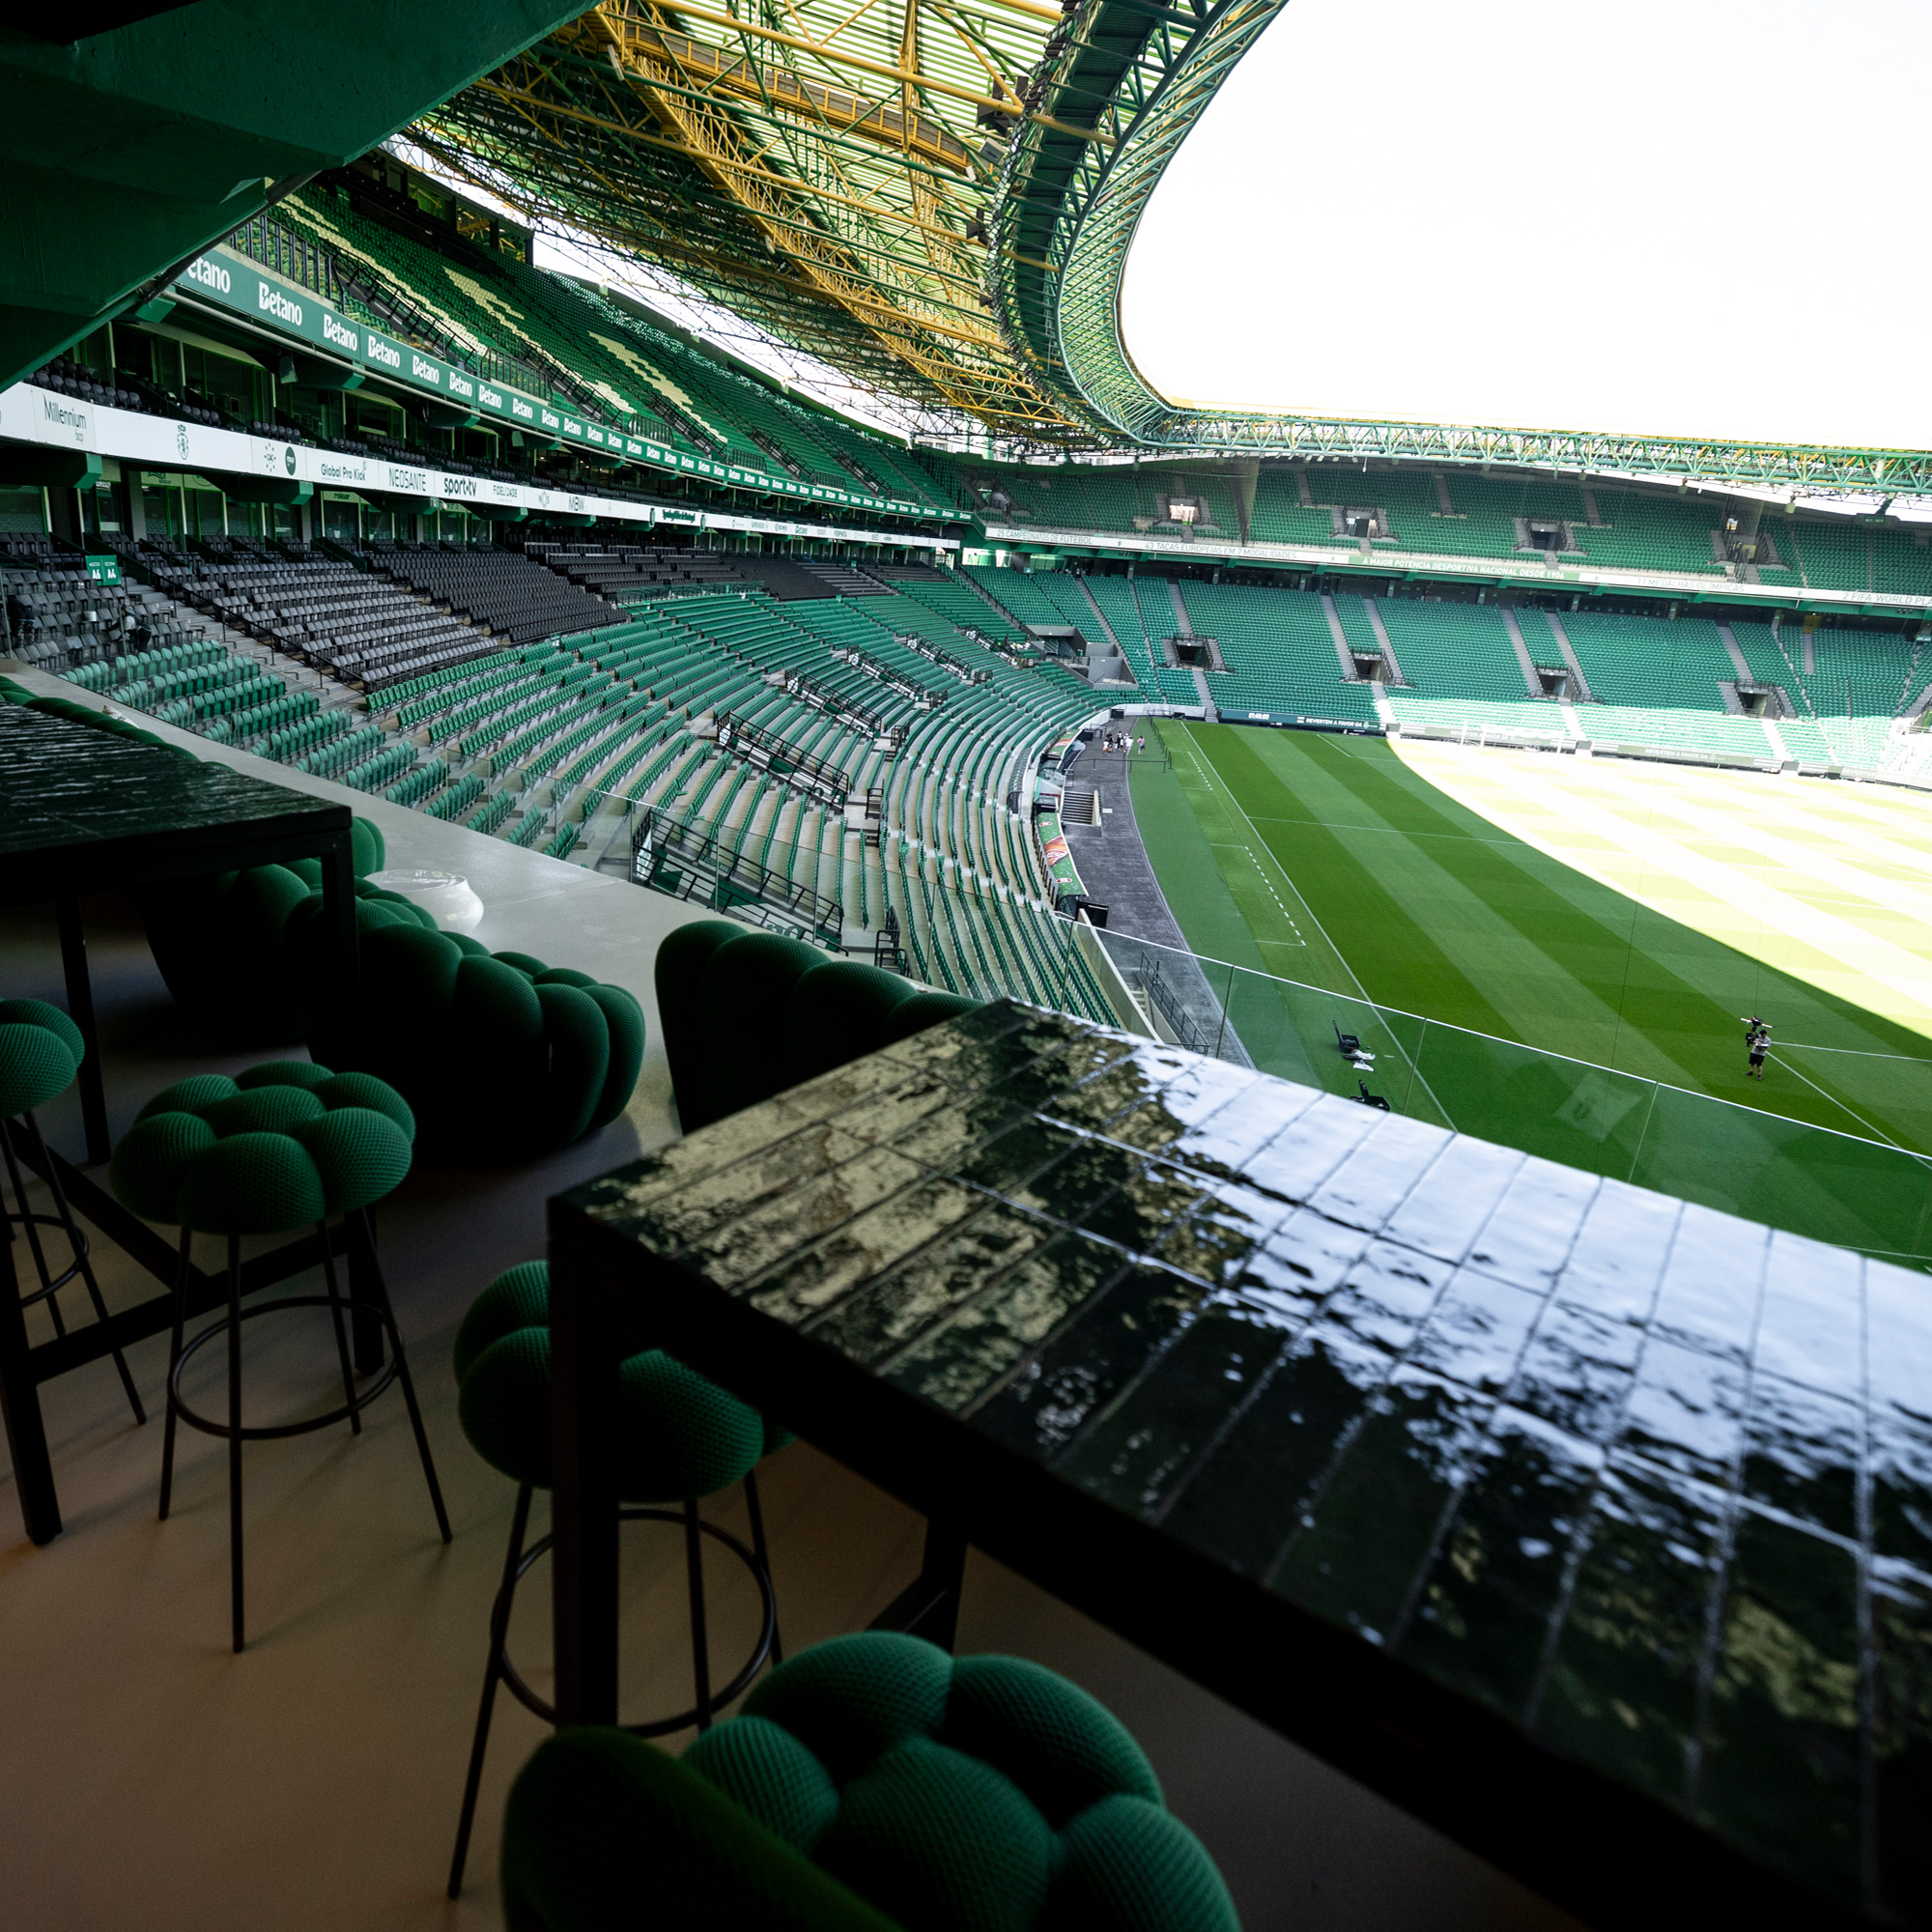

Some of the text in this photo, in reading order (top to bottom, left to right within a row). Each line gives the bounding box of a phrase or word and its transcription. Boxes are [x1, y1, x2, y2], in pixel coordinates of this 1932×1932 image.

[187, 257, 231, 294] etano
[259, 281, 303, 327] Betano
[324, 314, 357, 351] Betano
[368, 335, 400, 368] Betano
[412, 355, 440, 384] Betano
[449, 372, 472, 397] Betano
[479, 384, 501, 409] Betano
[512, 398, 532, 418] Betano
[542, 409, 559, 428] Betano
[43, 394, 87, 430] Millennium
[321, 463, 366, 481] Global Pro Kick
[388, 468, 426, 492] NEOSANTÉ
[1006, 530, 1050, 542] CAMPEONATOS
[1050, 533, 1060, 542] DE
[1060, 534, 1093, 545] FUTEBOL
[1180, 544, 1223, 554] EUROPEIAS
[1223, 546, 1236, 555] EM
[1243, 547, 1297, 559] MODALIDADES
[1370, 557, 1393, 567] MAIOR
[1432, 562, 1478, 574] DESPORTIVA
[1480, 565, 1518, 577] NACIONAL
[1520, 568, 1546, 579] DESDE
[1547, 571, 1565, 580] 1906
[1647, 579, 1694, 588] MEDALHAS
[1876, 594, 1913, 605] WORLD
